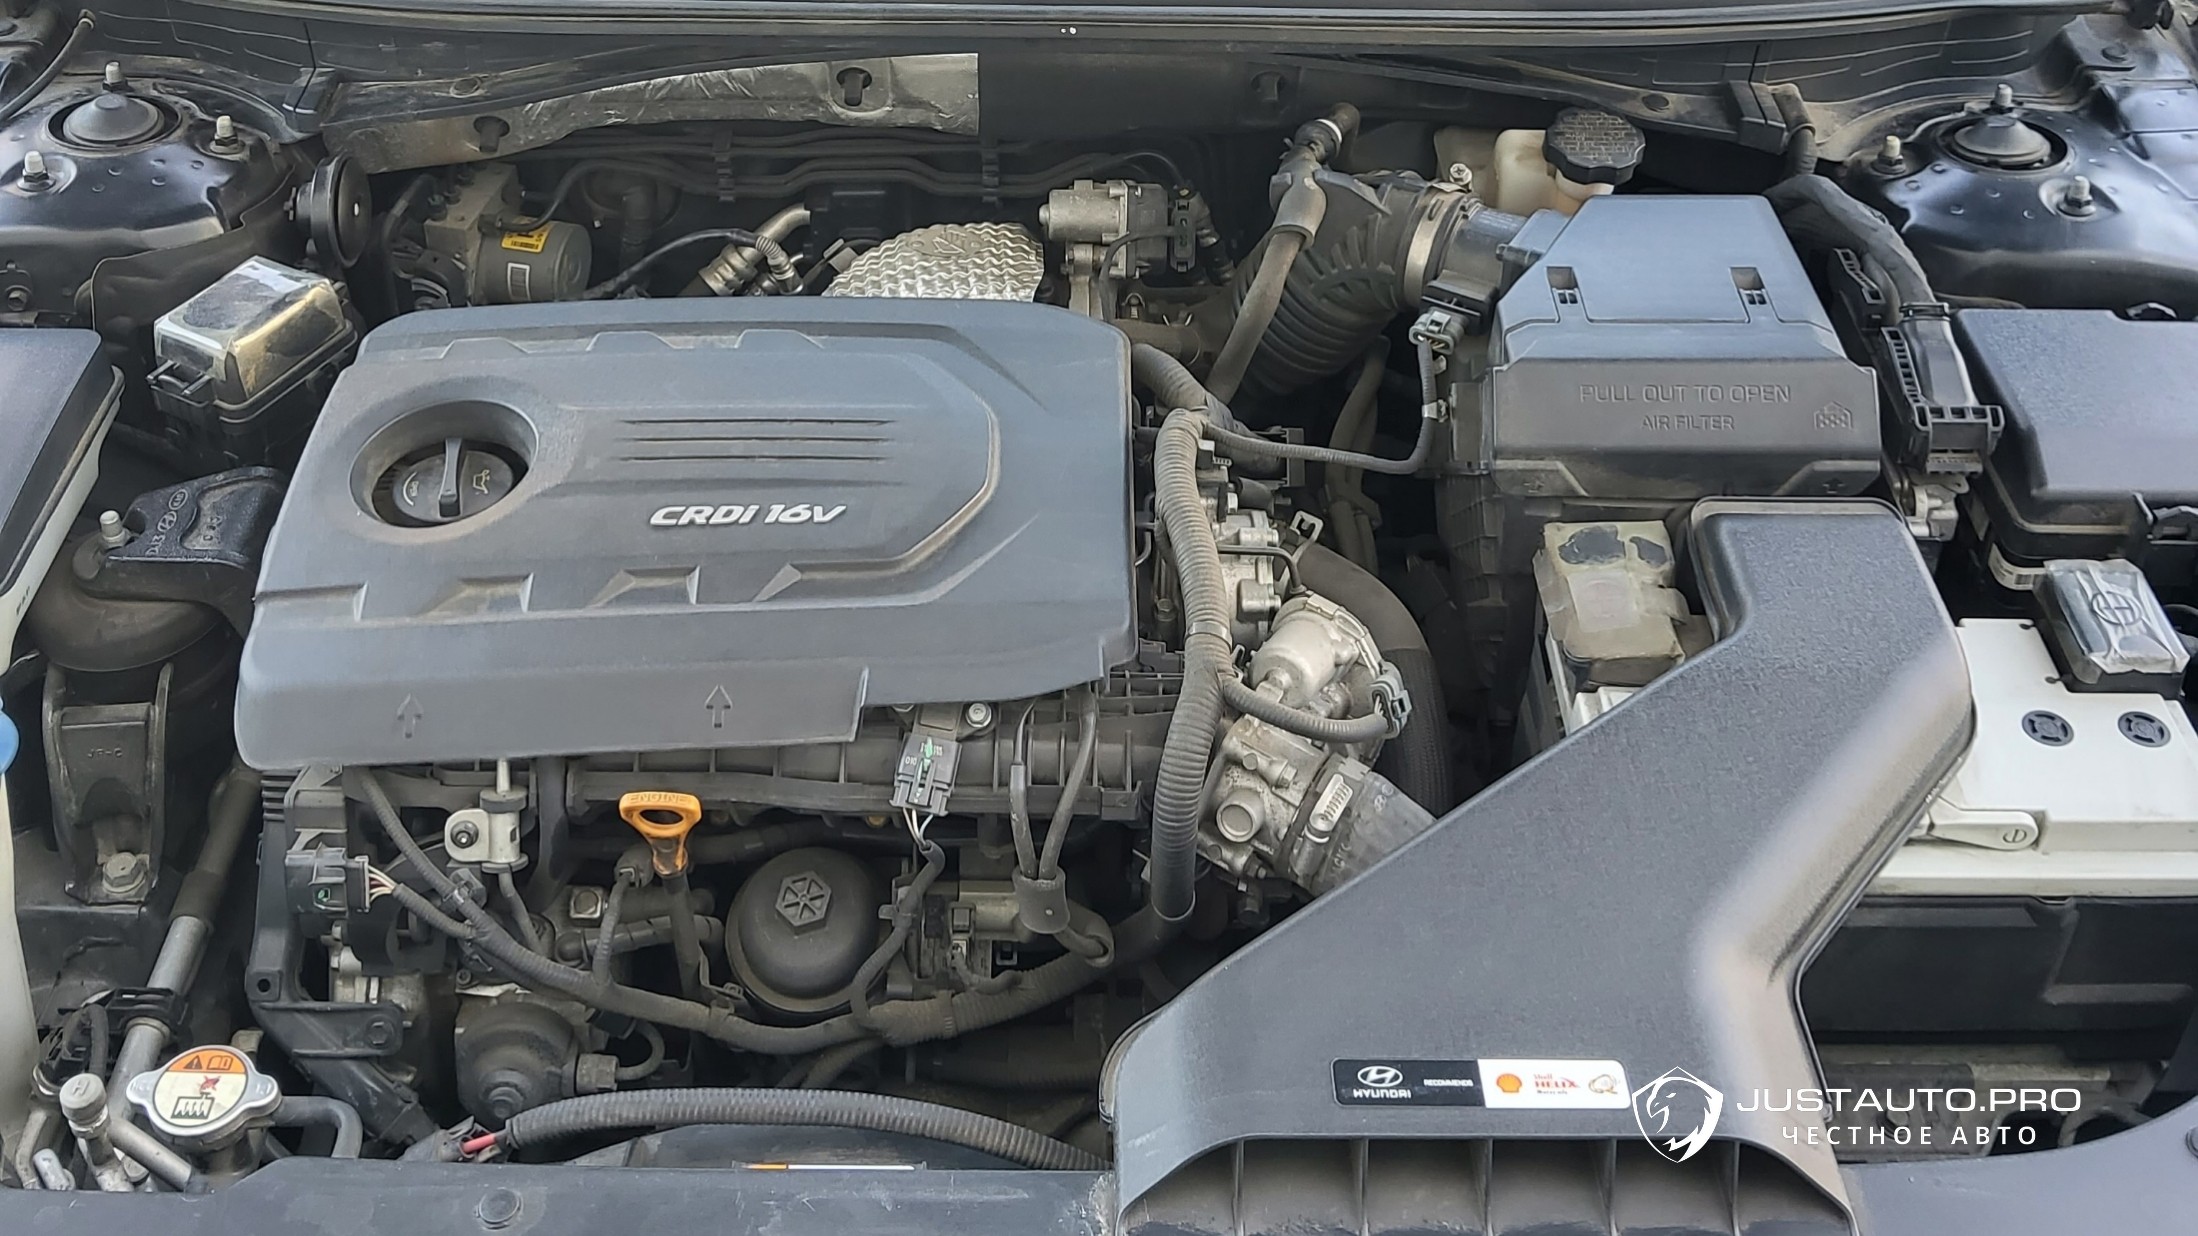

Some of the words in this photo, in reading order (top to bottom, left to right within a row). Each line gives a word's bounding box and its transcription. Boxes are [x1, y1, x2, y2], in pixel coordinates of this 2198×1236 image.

[1579, 384, 1638, 403] PULL
[1641, 384, 1688, 403] OUT
[1693, 385, 1724, 403] TO
[1729, 384, 1791, 403] OPEN
[1641, 415, 1671, 431] AIR
[1673, 415, 1735, 431] FILTER
[764, 504, 848, 524] 16V
[629, 793, 690, 805] ENGINE
[1353, 1088, 1412, 1099] HYUNDAI
